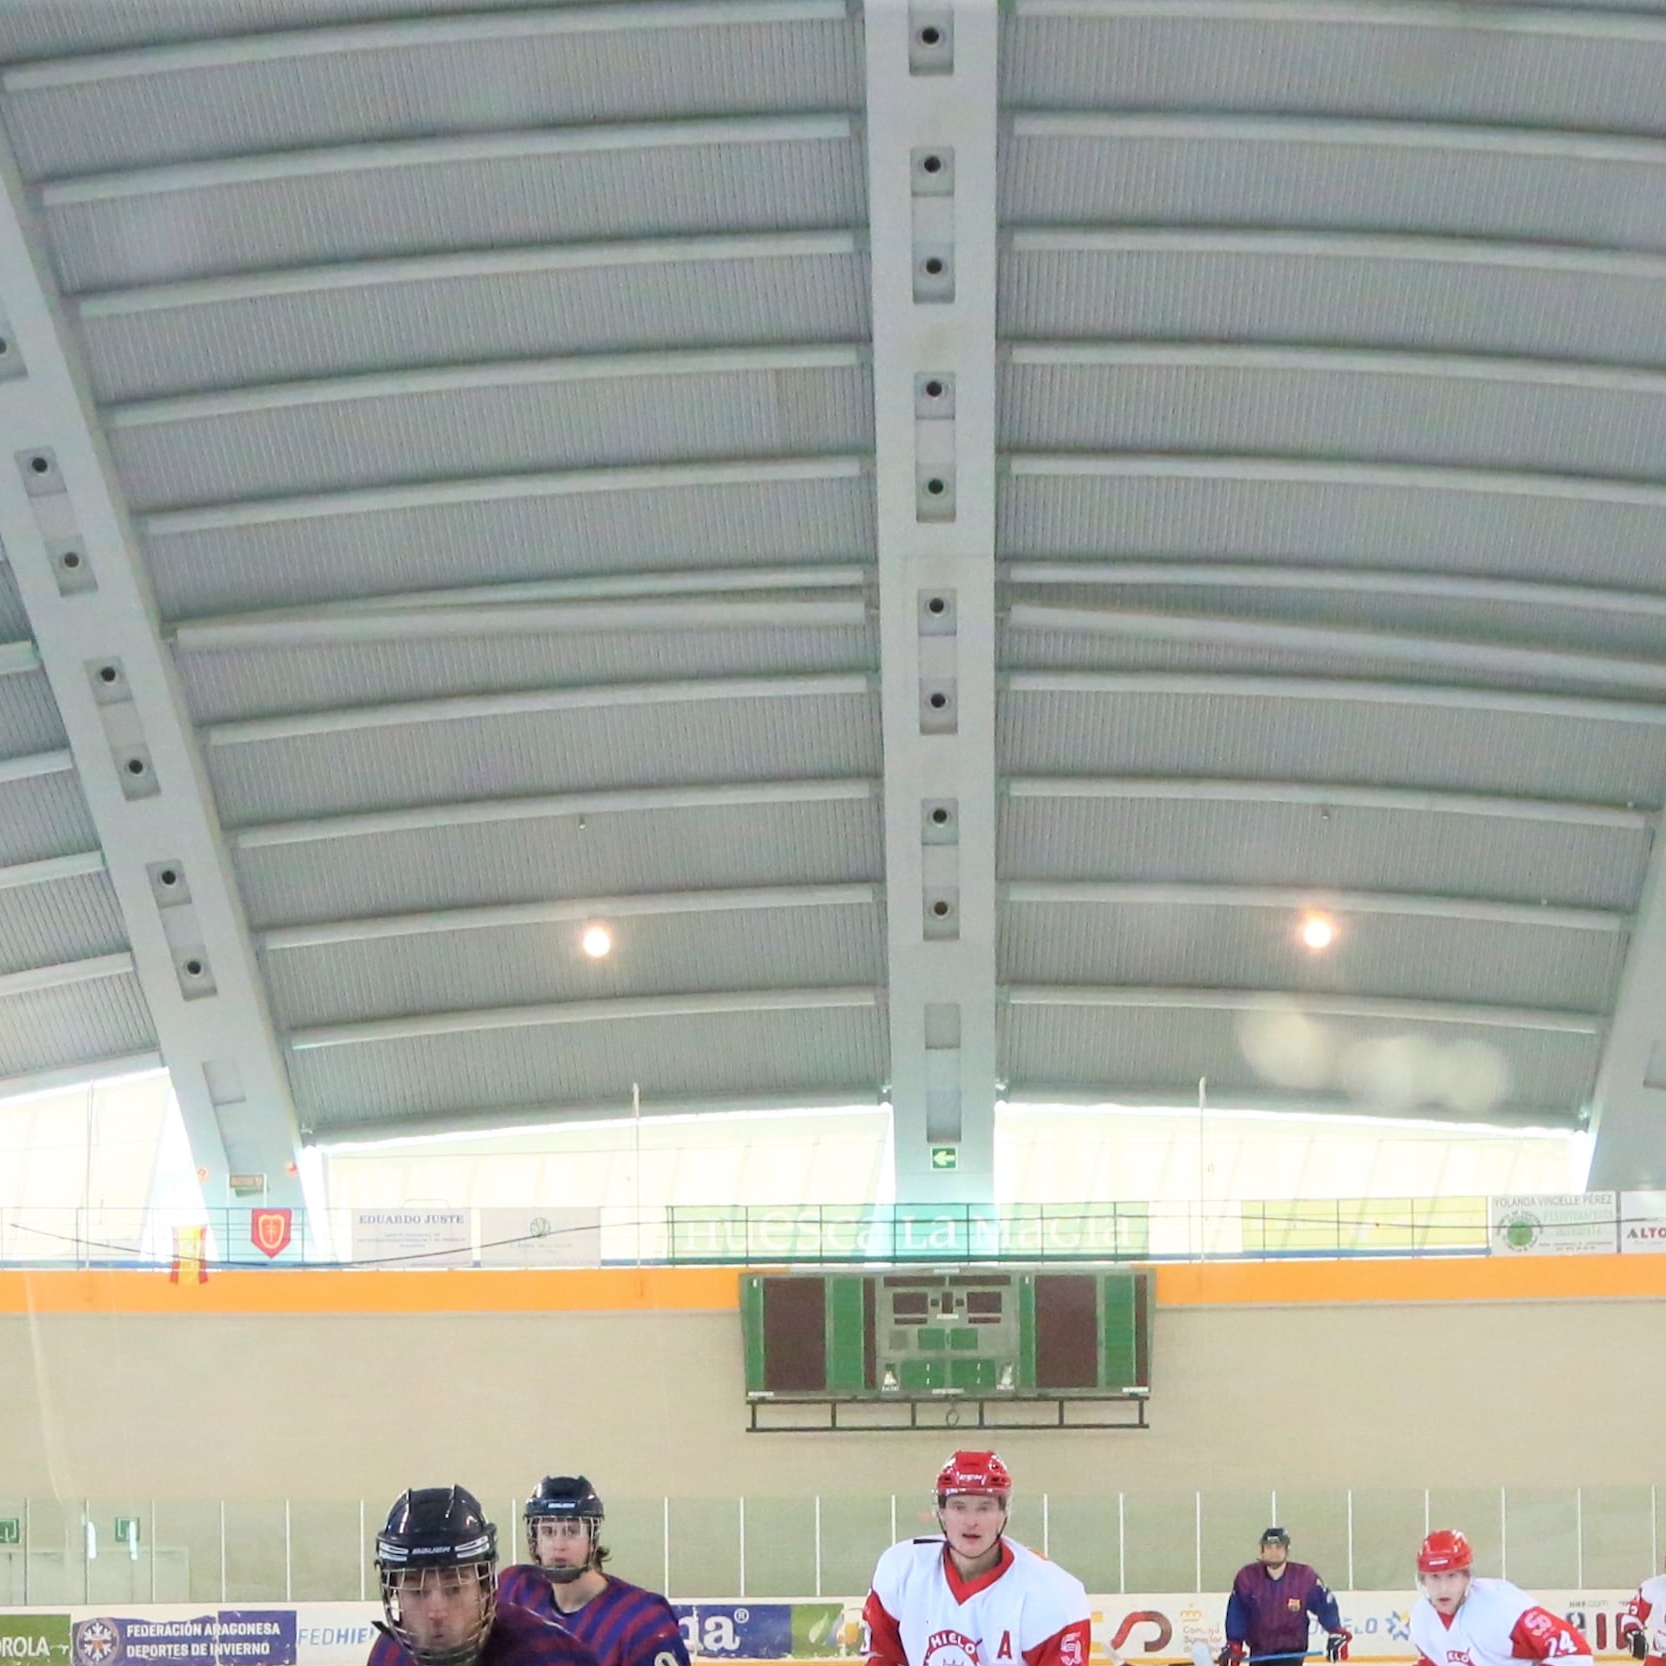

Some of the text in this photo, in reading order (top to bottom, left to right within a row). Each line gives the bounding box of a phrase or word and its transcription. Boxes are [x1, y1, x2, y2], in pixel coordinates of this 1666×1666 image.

[358, 1214, 465, 1225] EDUARDO JUSTE
[126, 1622, 281, 1638] FEDERACIÓN ARAGONESA
[126, 1641, 270, 1659] DEPORTES DE INVIERNO
[997, 1630, 1013, 1661] A
